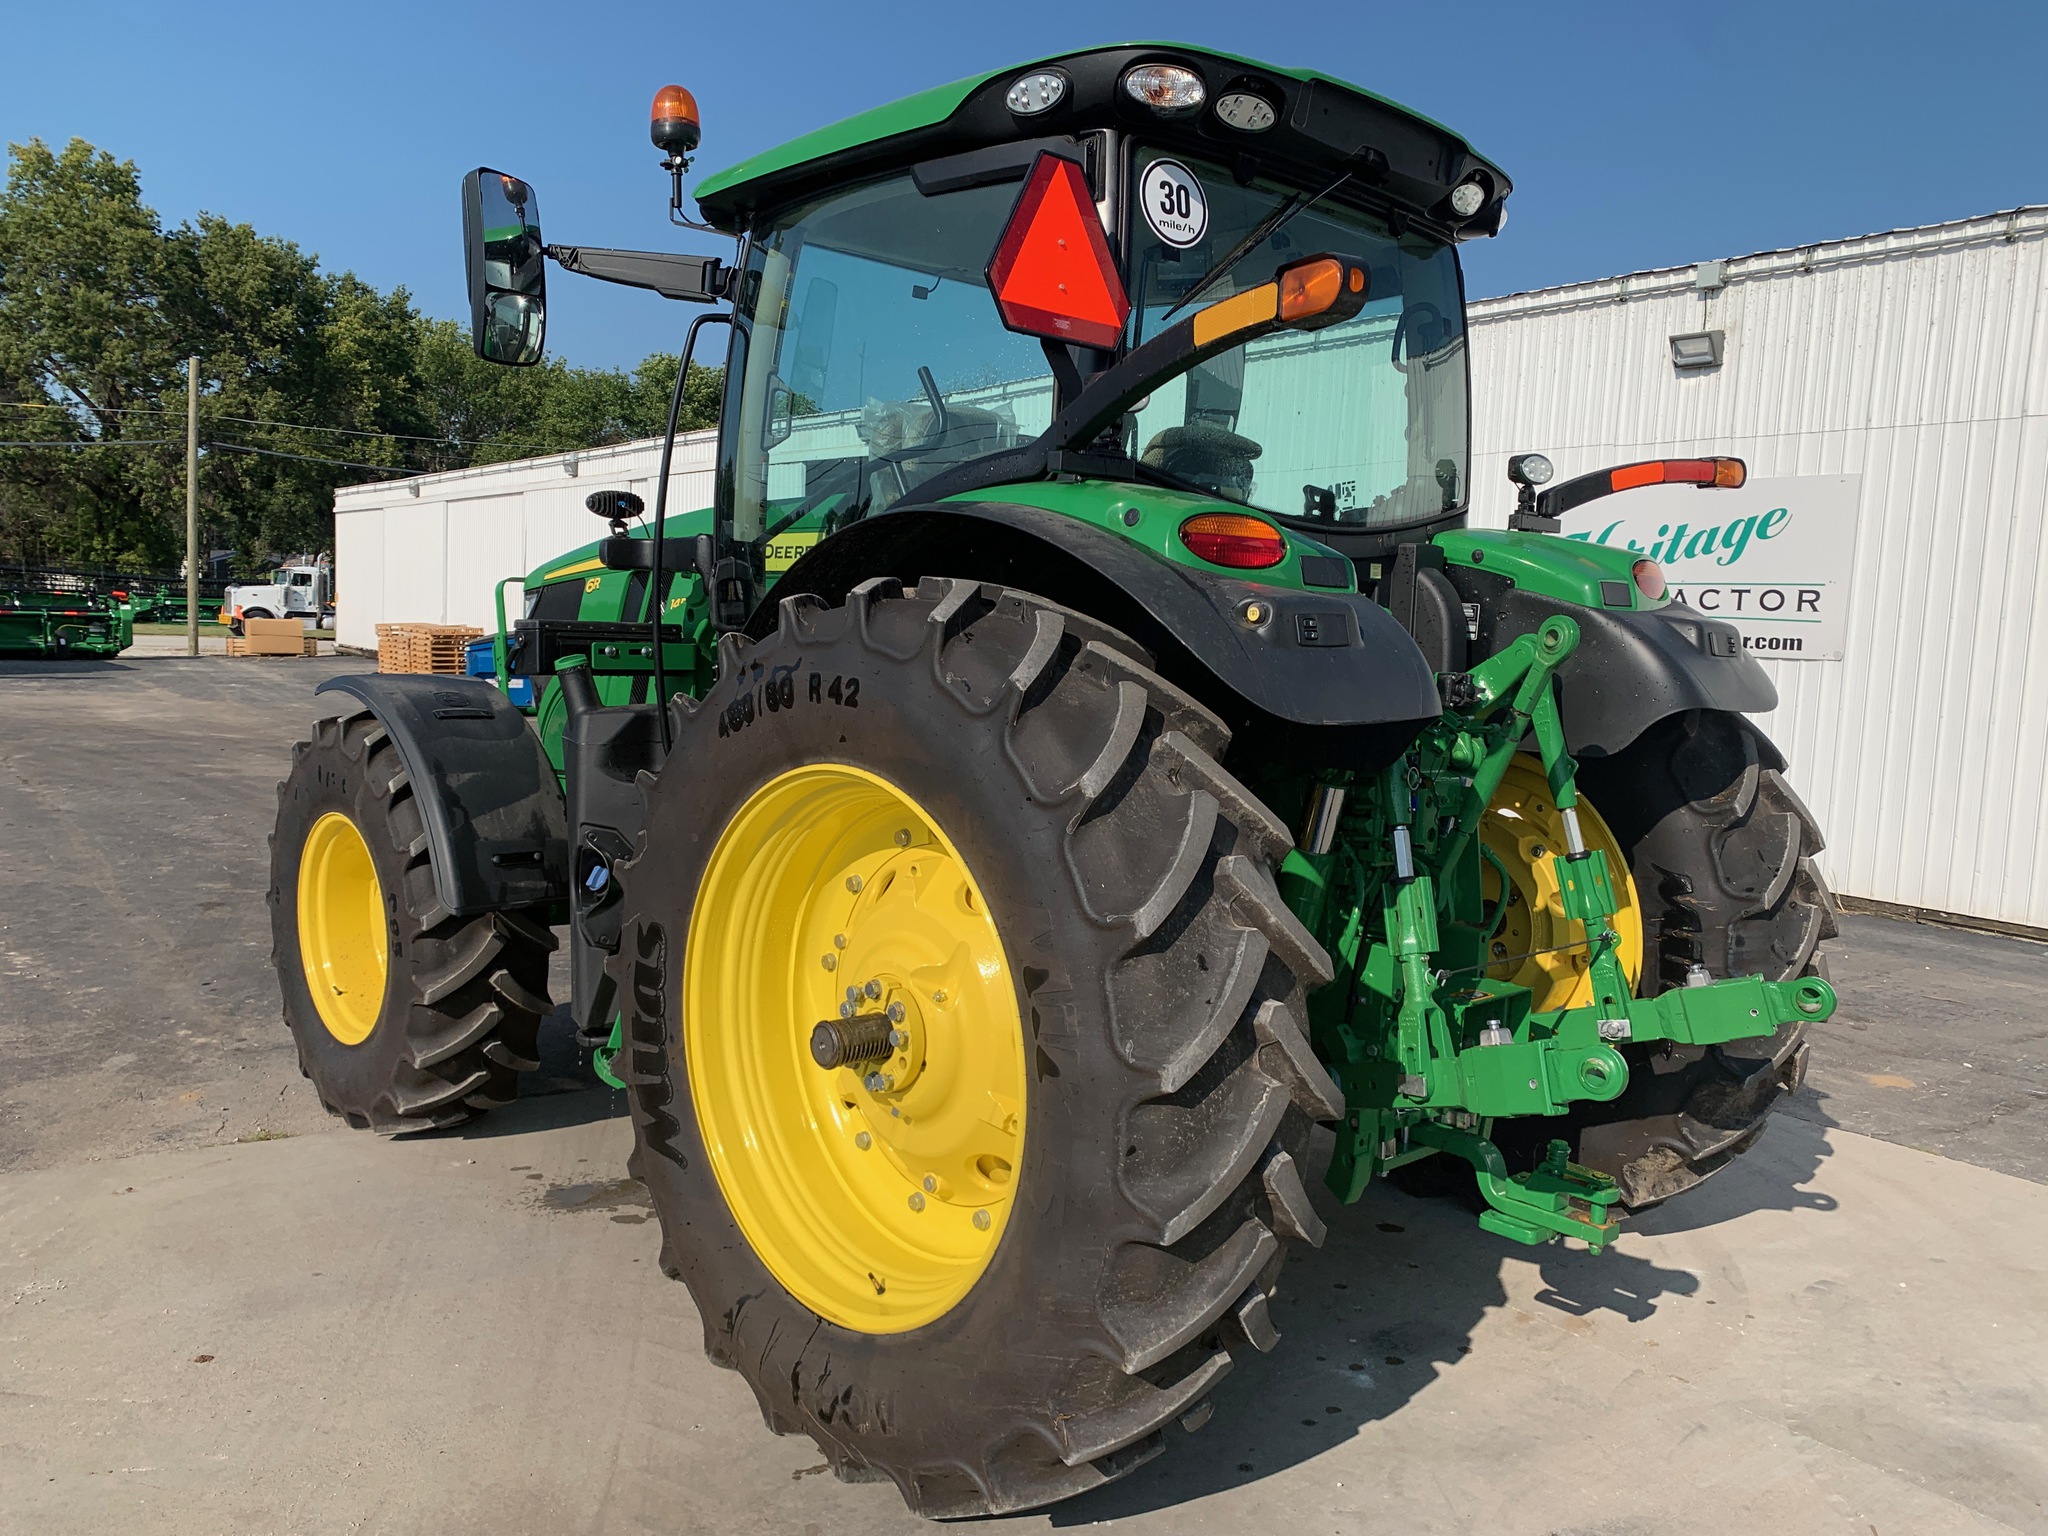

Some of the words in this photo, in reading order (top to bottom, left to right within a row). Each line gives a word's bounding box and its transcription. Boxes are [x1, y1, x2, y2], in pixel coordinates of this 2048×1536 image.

[1159, 180, 1191, 219] 30
[1159, 219, 1196, 235] mile/h
[585, 577, 601, 593] 6R
[631, 920, 688, 1171] Mitas
